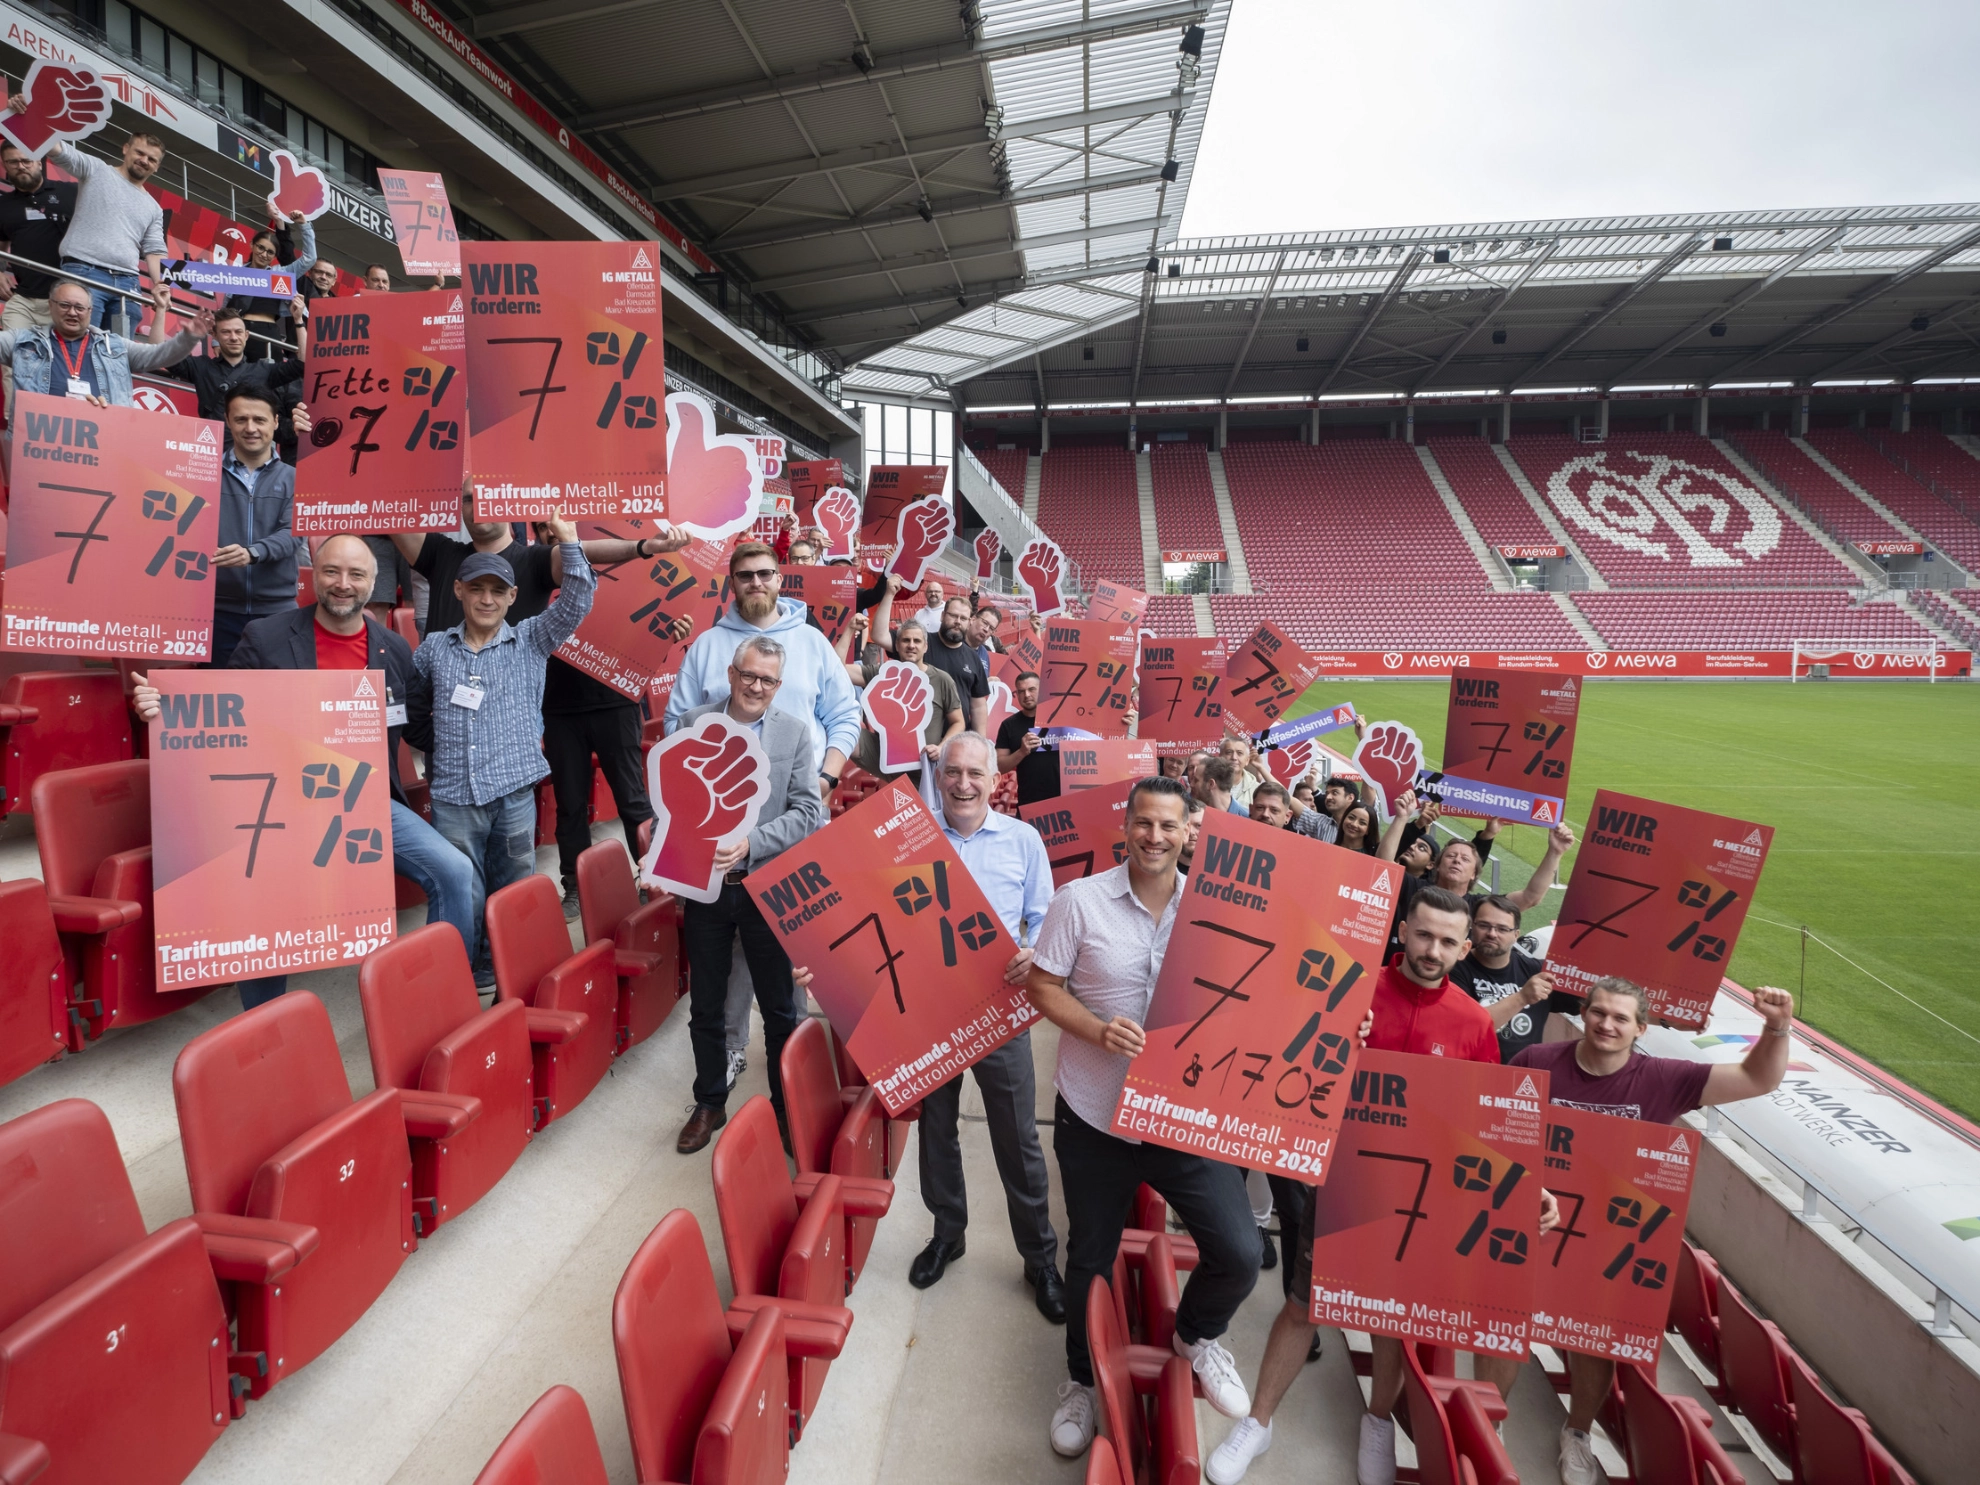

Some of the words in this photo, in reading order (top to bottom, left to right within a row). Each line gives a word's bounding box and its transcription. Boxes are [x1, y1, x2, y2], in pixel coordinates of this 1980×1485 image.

[412, 0, 513, 98] #BockAufTeamwork
[383, 177, 407, 190] WIR
[331, 189, 380, 234] INZER
[161, 267, 268, 288] Antifaschismus
[468, 264, 539, 295] WIR
[602, 272, 613, 282] IG
[616, 272, 654, 282] METALL
[470, 297, 540, 314] fordern:
[316, 314, 370, 342] WIR
[423, 317, 432, 325] IG
[313, 343, 369, 358] fordern:
[311, 367, 390, 403] Fette
[26, 412, 98, 449] WIR
[23, 442, 98, 466] fordern:
[166, 440, 176, 449] IG
[179, 442, 217, 455] METALL
[872, 472, 899, 482] WIR
[475, 484, 560, 499] Tarifrunde
[566, 482, 623, 497] Metall-
[633, 481, 664, 496] und
[296, 501, 368, 516] Tarifrunde
[372, 499, 422, 513] Metall-
[431, 497, 458, 511] und
[478, 500, 616, 516] Elektroindustrie
[622, 498, 664, 513] 2024
[297, 514, 415, 531] Elektroindustrie
[420, 513, 456, 526] 2024
[5, 615, 99, 634] Tarifrunde
[105, 622, 166, 638] Metall-
[176, 628, 208, 641] und
[1050, 627, 1080, 643] WIR
[1255, 627, 1282, 652] WIR
[7, 632, 158, 653] Elektroindustrie
[164, 641, 206, 656] 2024
[1048, 643, 1079, 652] fordern:
[1144, 648, 1174, 661] WIR
[581, 642, 620, 669] Metall-
[624, 669, 649, 686] und
[610, 673, 640, 696] 2024
[1457, 679, 1499, 698] WIR
[160, 694, 246, 729] WIR
[321, 701, 333, 711] IG
[336, 700, 379, 711] METALL
[1454, 696, 1498, 708] fordern:
[160, 730, 247, 750] fordern:
[1256, 715, 1333, 750] Antifaschismus
[1064, 751, 1097, 766] WIR
[1415, 778, 1529, 812] Antirassismus
[874, 826, 886, 838] IG
[885, 804, 921, 831] METALL
[1028, 810, 1075, 835] WIR
[1598, 806, 1657, 841] WIR
[1590, 831, 1650, 855] fordern:
[1713, 840, 1724, 848] IG
[1725, 842, 1760, 856] METALL
[1204, 836, 1276, 890] WIR
[760, 862, 831, 918] WIR
[1194, 874, 1268, 912] fordern:
[1338, 886, 1350, 898] IG
[1351, 889, 1389, 910] METALL
[778, 892, 842, 936] fordern:
[159, 935, 268, 963] Tarifrunde
[275, 925, 345, 948] Metall-
[356, 918, 391, 938] und
[164, 945, 337, 983] Elektroindustrie
[1664, 1005, 1701, 1022] 2024
[1678, 998, 1708, 1011] und
[486, 1051, 496, 1070] 33
[874, 1042, 951, 1095] Tarifrunde
[951, 1006, 1002, 1046] Metall-
[886, 1025, 1007, 1109] Elektroindustrie
[1480, 1095, 1492, 1106] IG
[1494, 1097, 1540, 1112] METALL
[1124, 1087, 1217, 1128] Tarifrunde
[1221, 1114, 1285, 1143] Metall-
[1294, 1137, 1330, 1156] und
[1765, 1088, 1852, 1148] ADTWERKE
[1782, 1080, 1912, 1157] MAINZER
[1118, 1108, 1272, 1164] Elektroindustrie
[1276, 1150, 1322, 1176] 2024
[1637, 1148, 1648, 1157] IG
[1650, 1150, 1689, 1165] METALL
[339, 1159, 356, 1182] 32
[1314, 1286, 1405, 1315] Tarifrunde
[1412, 1304, 1478, 1327] Metall-
[1489, 1320, 1526, 1337] und
[1315, 1303, 1468, 1344] Elektroindustrie
[1474, 1332, 1523, 1354] 2024
[1559, 1316, 1615, 1337] Metall-
[1625, 1334, 1658, 1348] und
[1610, 1342, 1653, 1362] 2024
